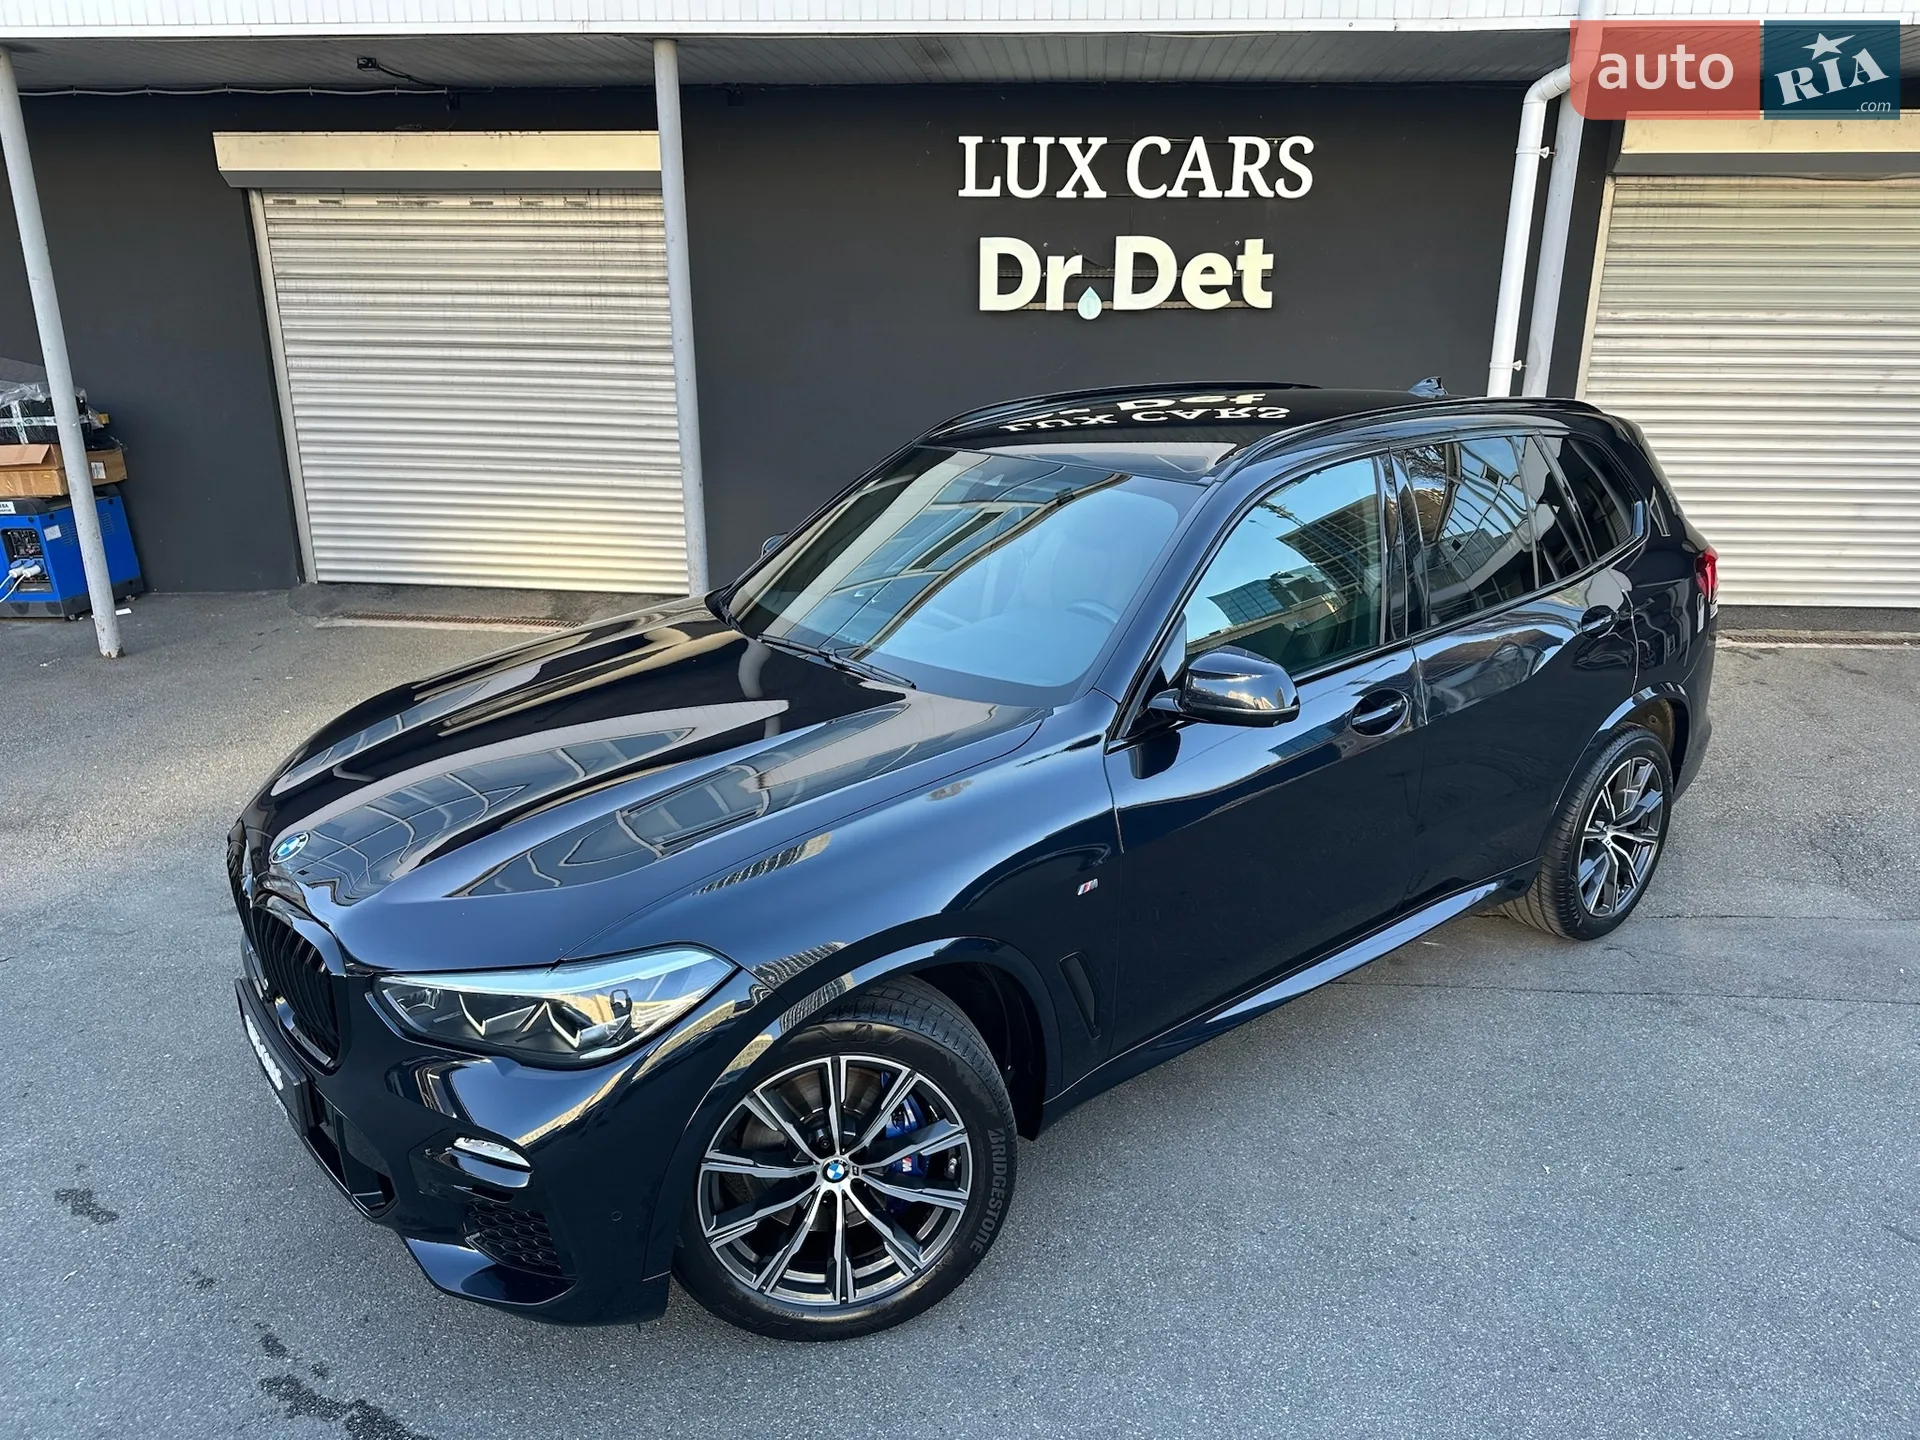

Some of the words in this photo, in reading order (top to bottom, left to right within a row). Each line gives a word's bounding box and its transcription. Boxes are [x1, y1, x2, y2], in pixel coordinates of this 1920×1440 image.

[957, 135, 1108, 199] LUX
[1126, 135, 1315, 200] CARS
[970, 1128, 1008, 1254] BRIDGESTONE
